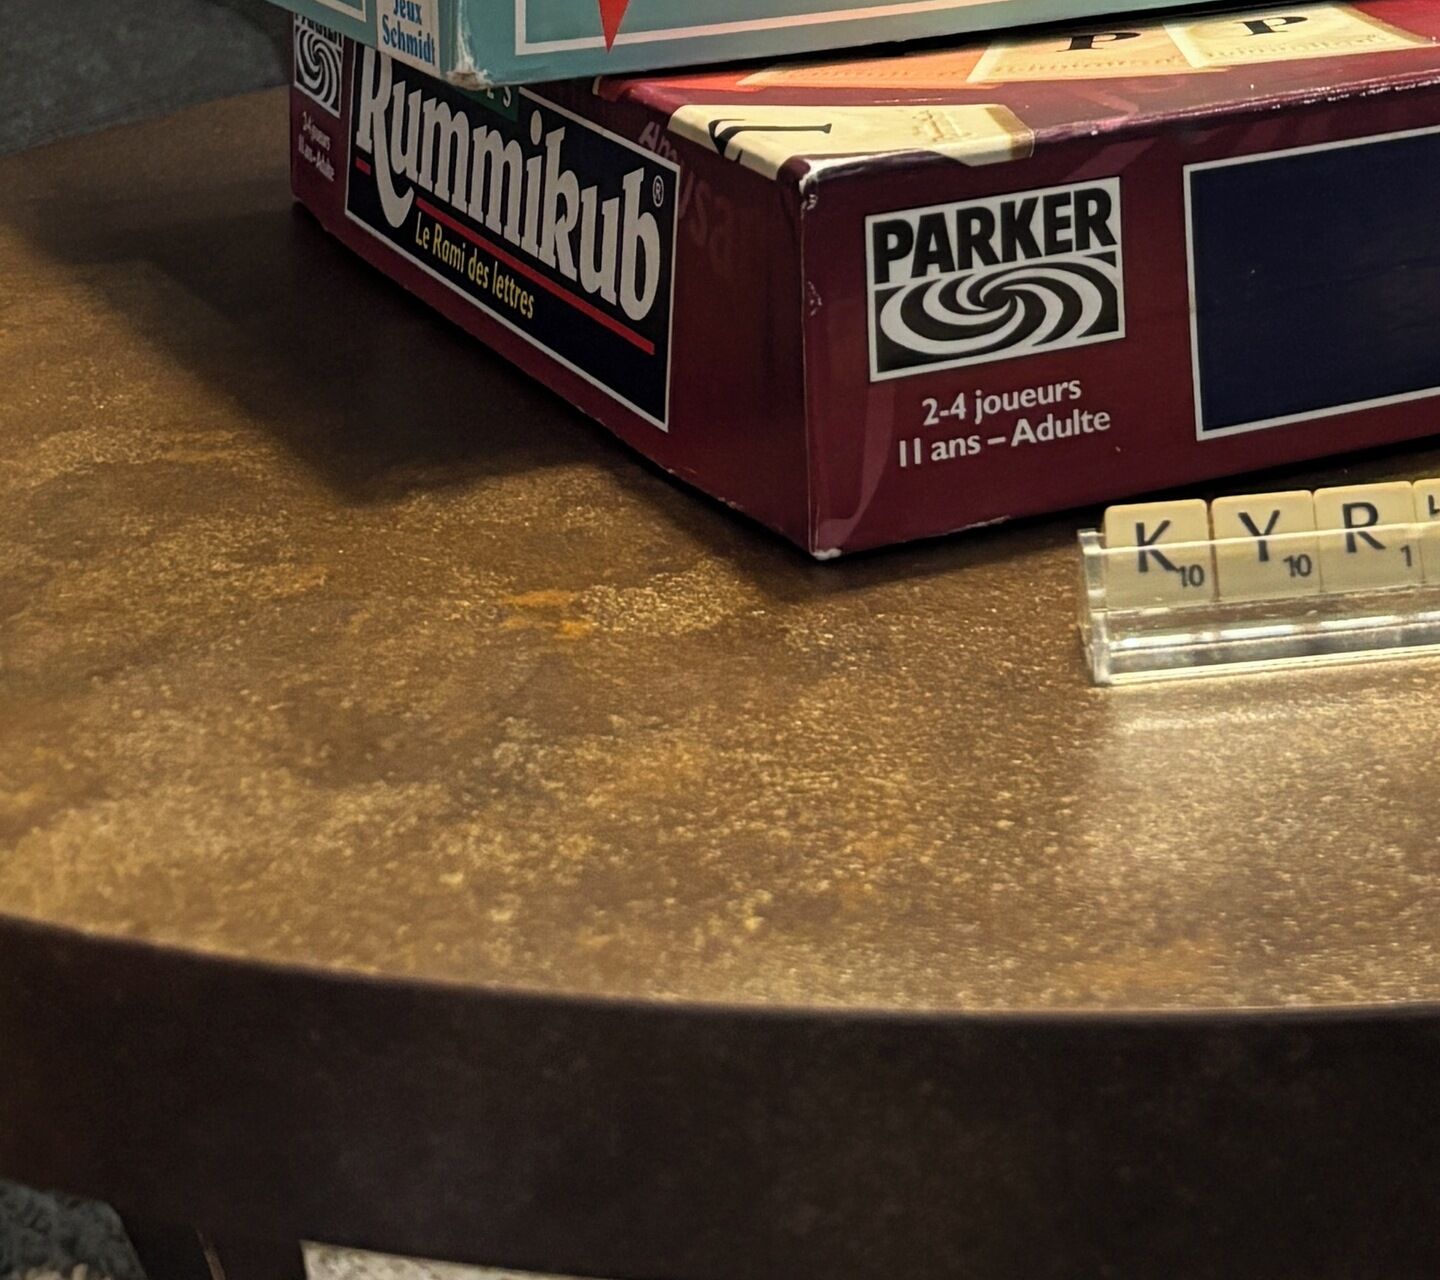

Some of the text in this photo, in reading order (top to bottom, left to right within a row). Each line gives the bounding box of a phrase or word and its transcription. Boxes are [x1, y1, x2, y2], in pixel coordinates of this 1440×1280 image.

[382, 14, 436, 67] Schmidt
[356, 44, 662, 322] Rummikub
[415, 212, 535, 320] Le Rami des lettres
[874, 179, 1115, 284] PARKER
[922, 380, 1082, 427] 2-4 joueurs
[930, 434, 981, 463] ans
[1011, 409, 1111, 450] Adulte
